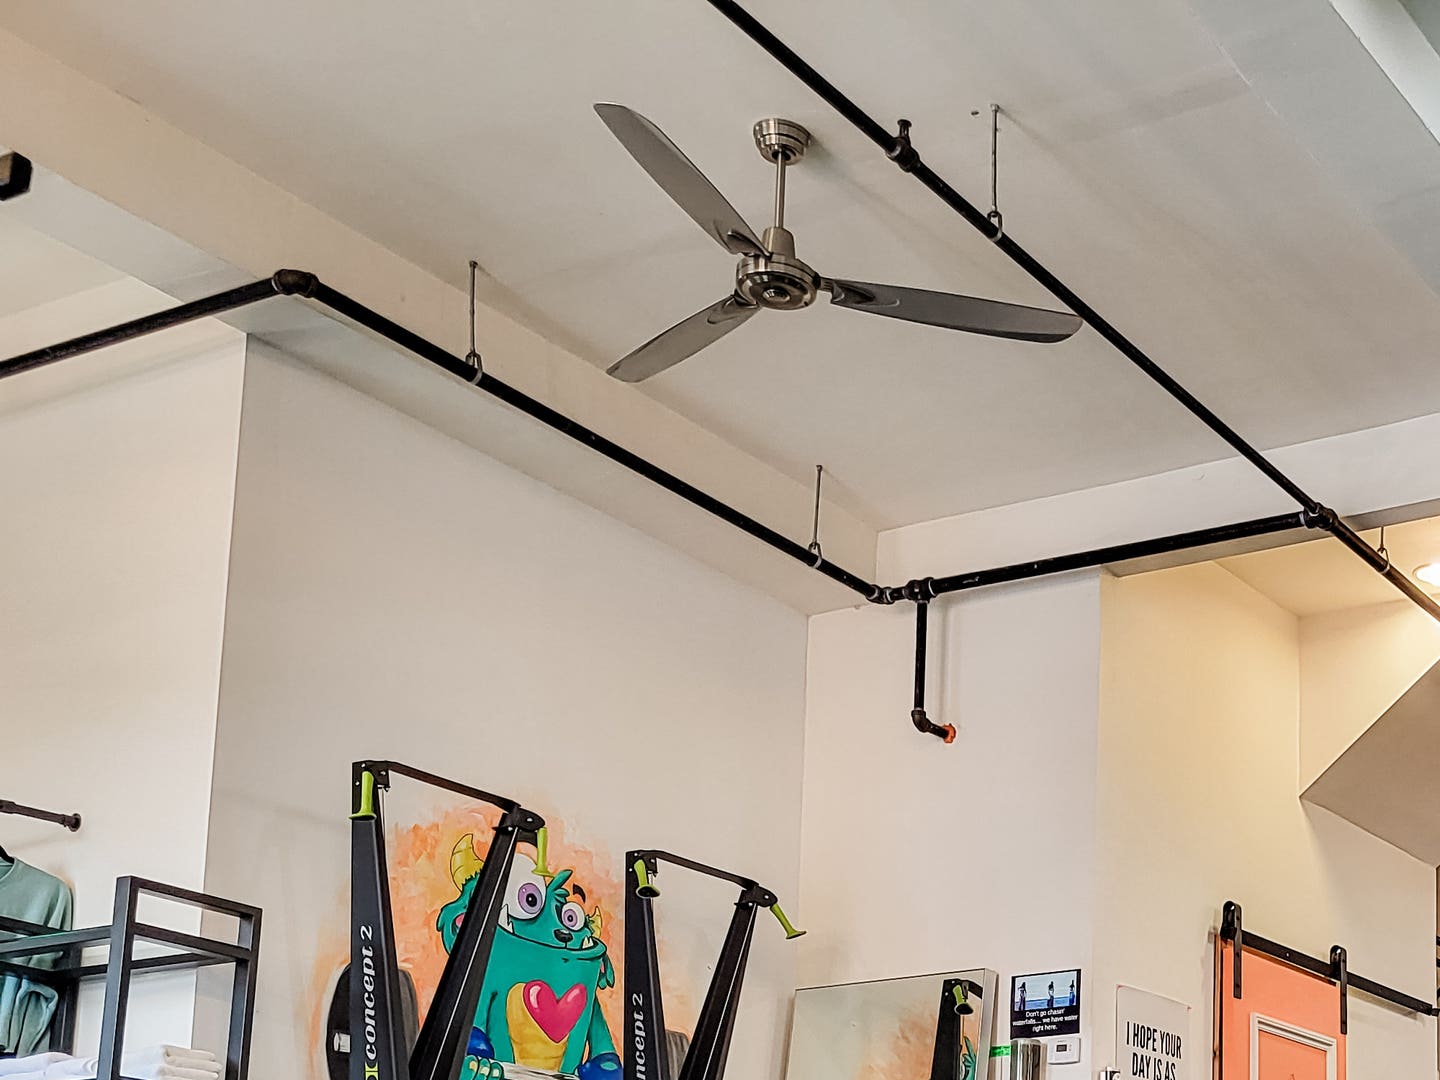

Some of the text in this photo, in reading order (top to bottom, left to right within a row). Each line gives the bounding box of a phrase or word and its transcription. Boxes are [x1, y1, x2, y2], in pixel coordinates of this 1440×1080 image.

[360, 924, 377, 1060] concept 2
[632, 992, 643, 1007] 2
[1126, 1021, 1182, 1059] I HOPE YOUR
[1132, 1052, 1151, 1080] DAY
